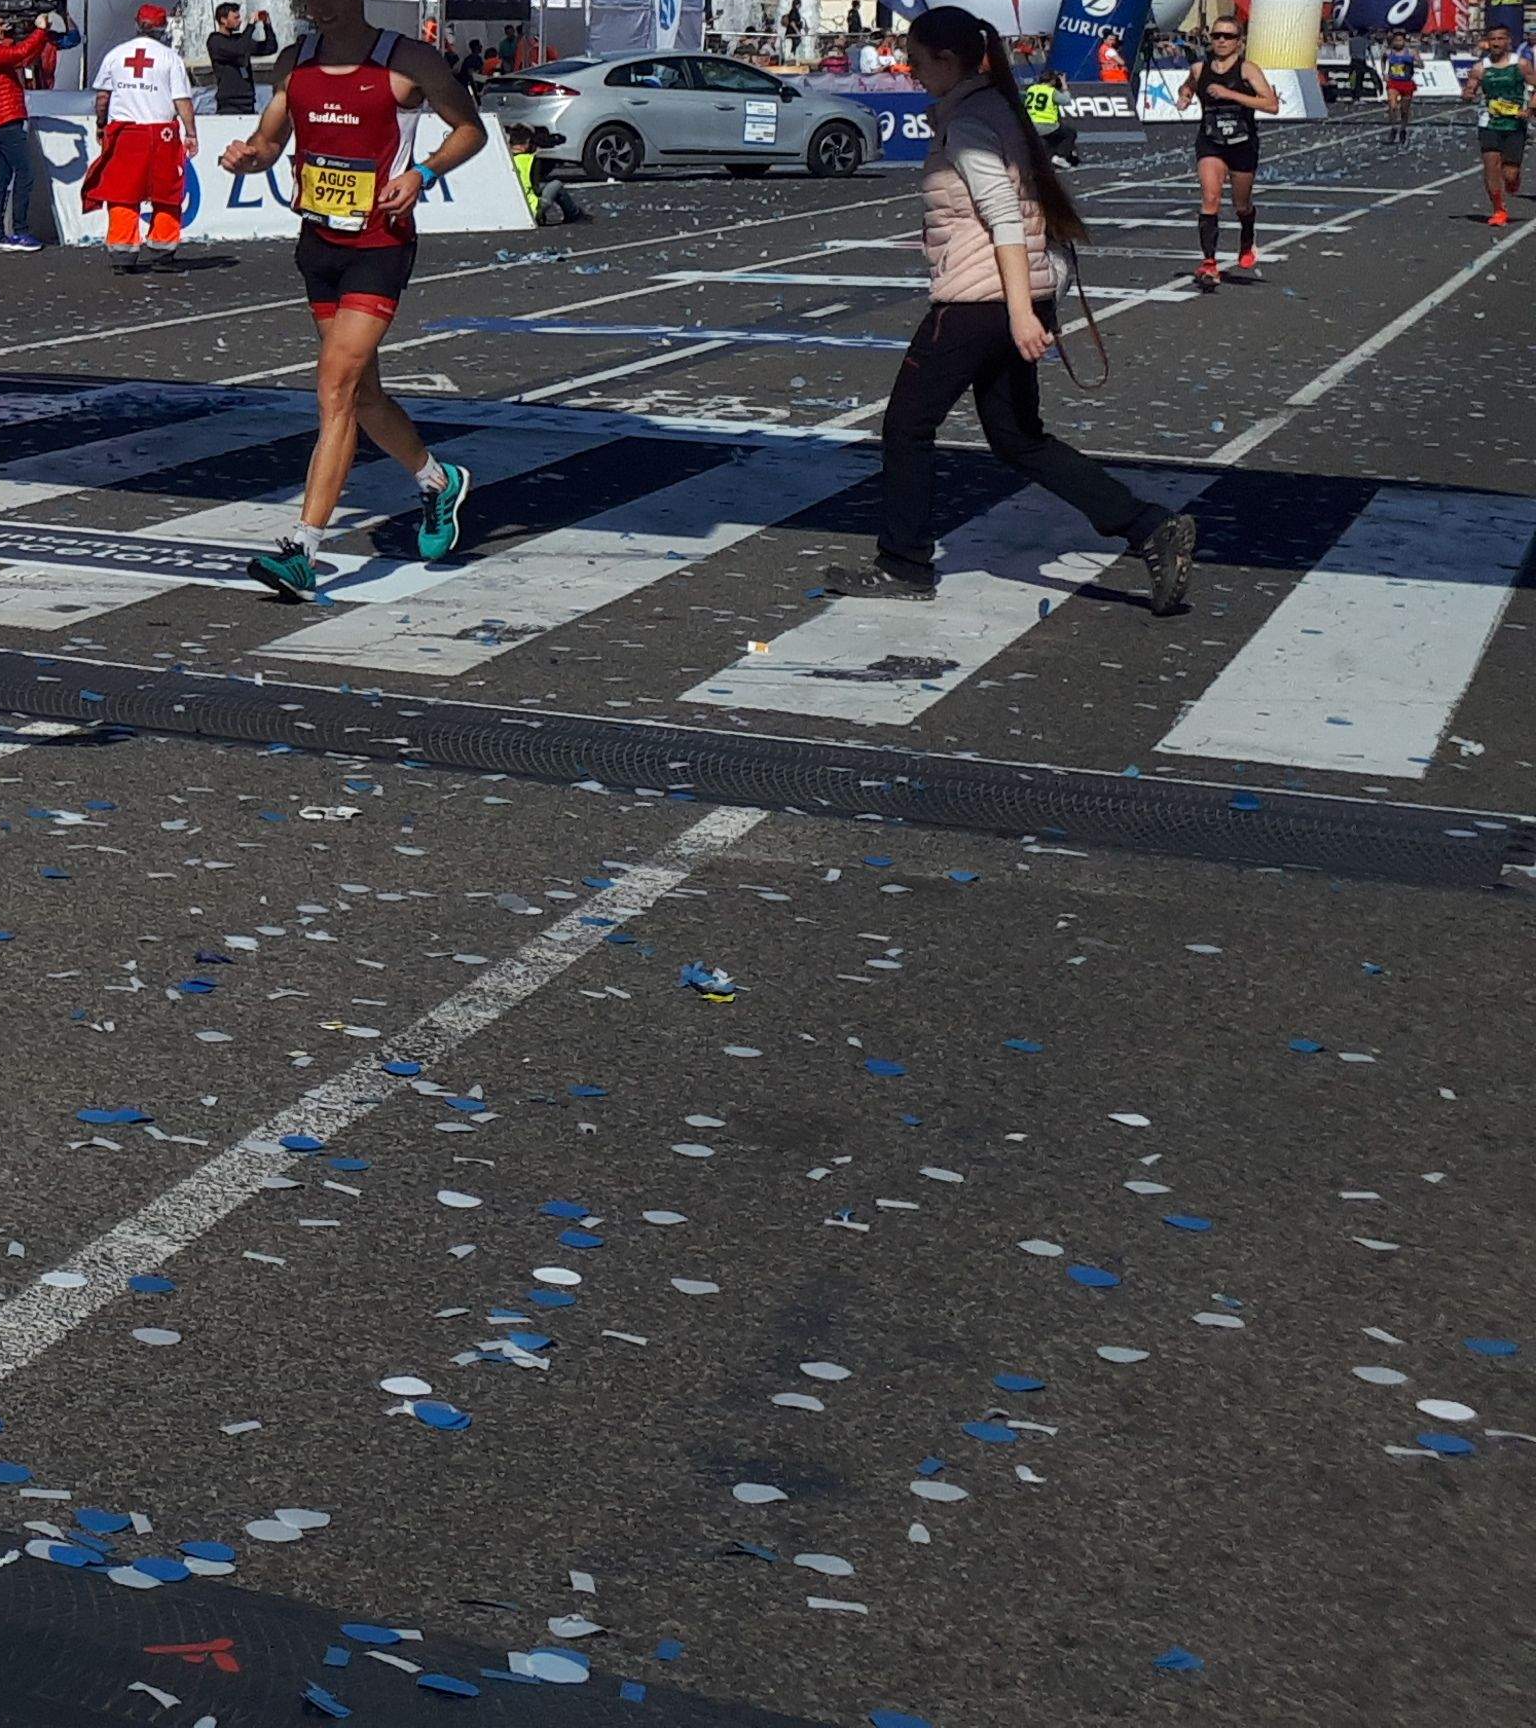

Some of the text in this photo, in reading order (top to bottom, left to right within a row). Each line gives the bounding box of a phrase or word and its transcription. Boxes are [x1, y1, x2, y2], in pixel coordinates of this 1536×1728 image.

[1059, 15, 1126, 40] ZURICH
[1026, 92, 1048, 111] 29
[317, 171, 358, 188] AGUS
[315, 186, 358, 207] 9771
